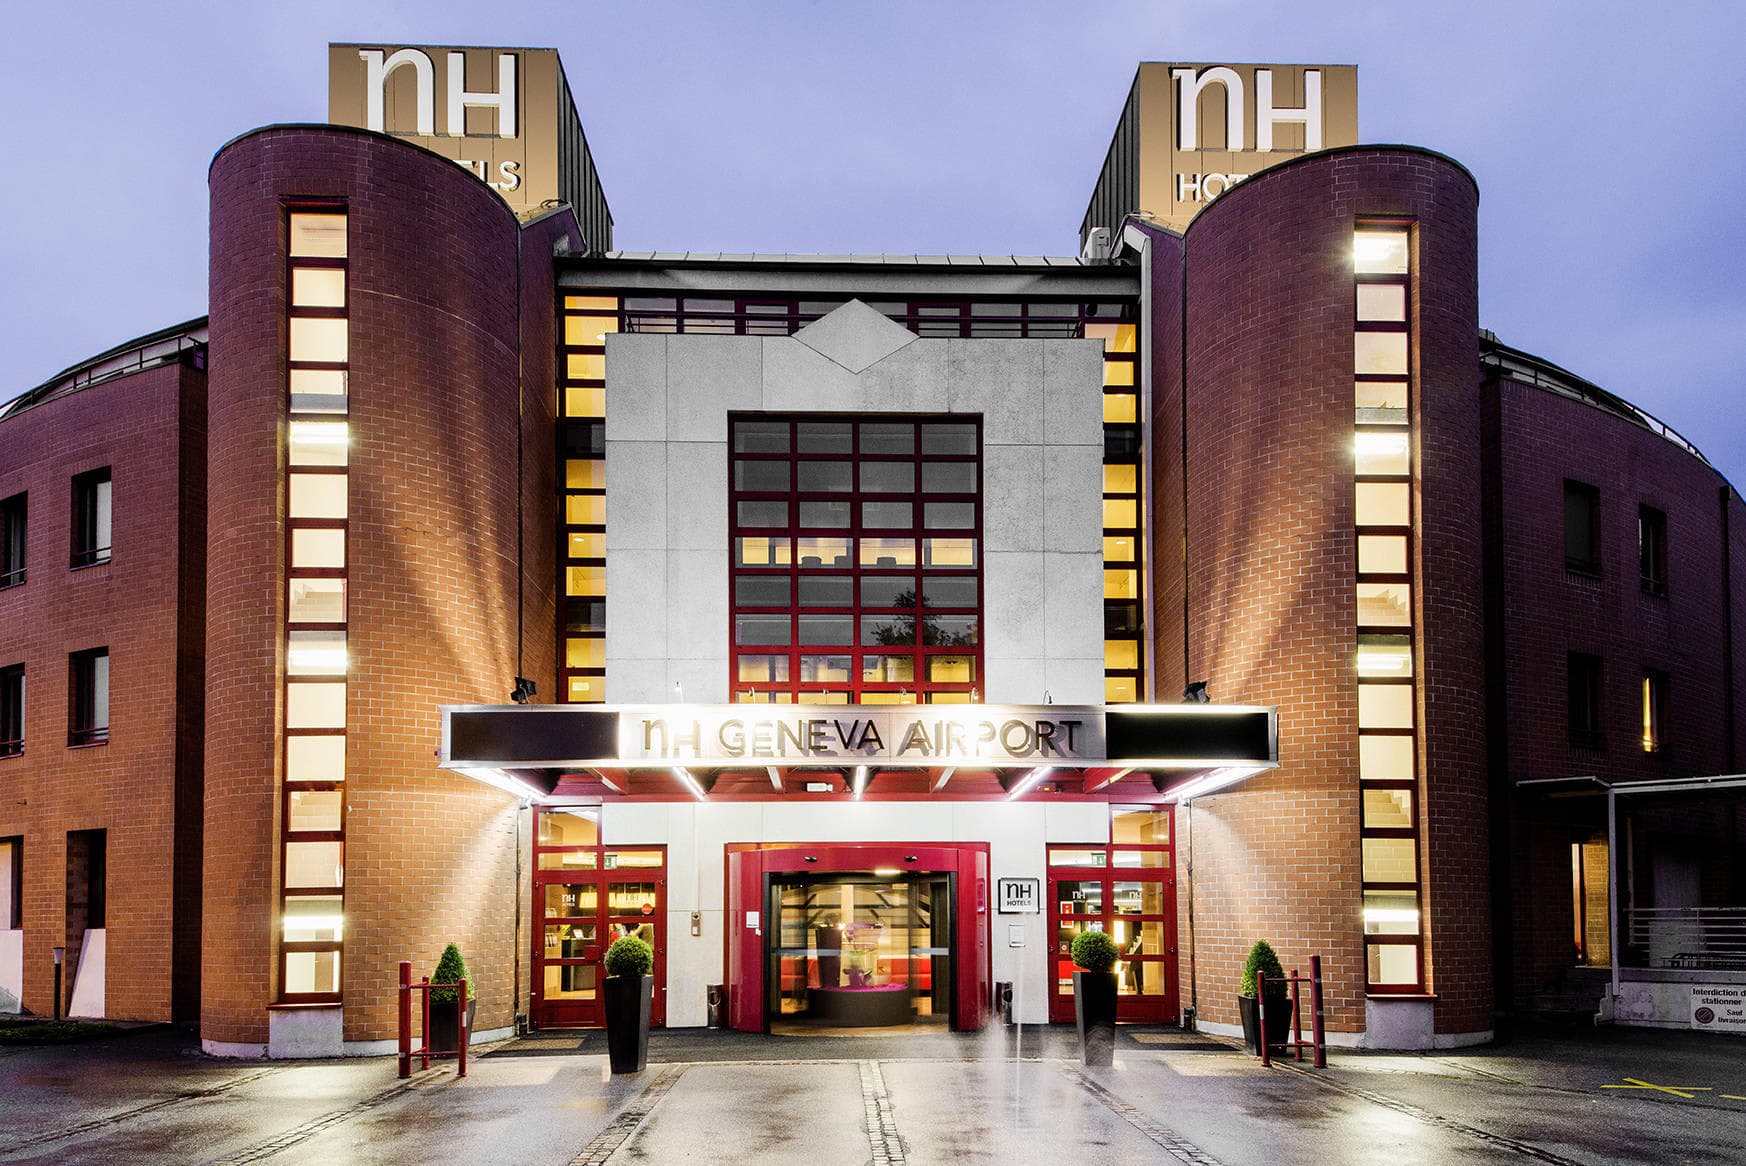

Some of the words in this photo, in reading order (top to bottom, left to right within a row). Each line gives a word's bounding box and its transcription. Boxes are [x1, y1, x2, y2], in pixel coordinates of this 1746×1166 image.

[719, 719, 884, 753] GENEVA
[901, 719, 1083, 753] AIRPORT
[1692, 988, 1738, 996] Interdiction
[1702, 997, 1742, 1005] stationner
